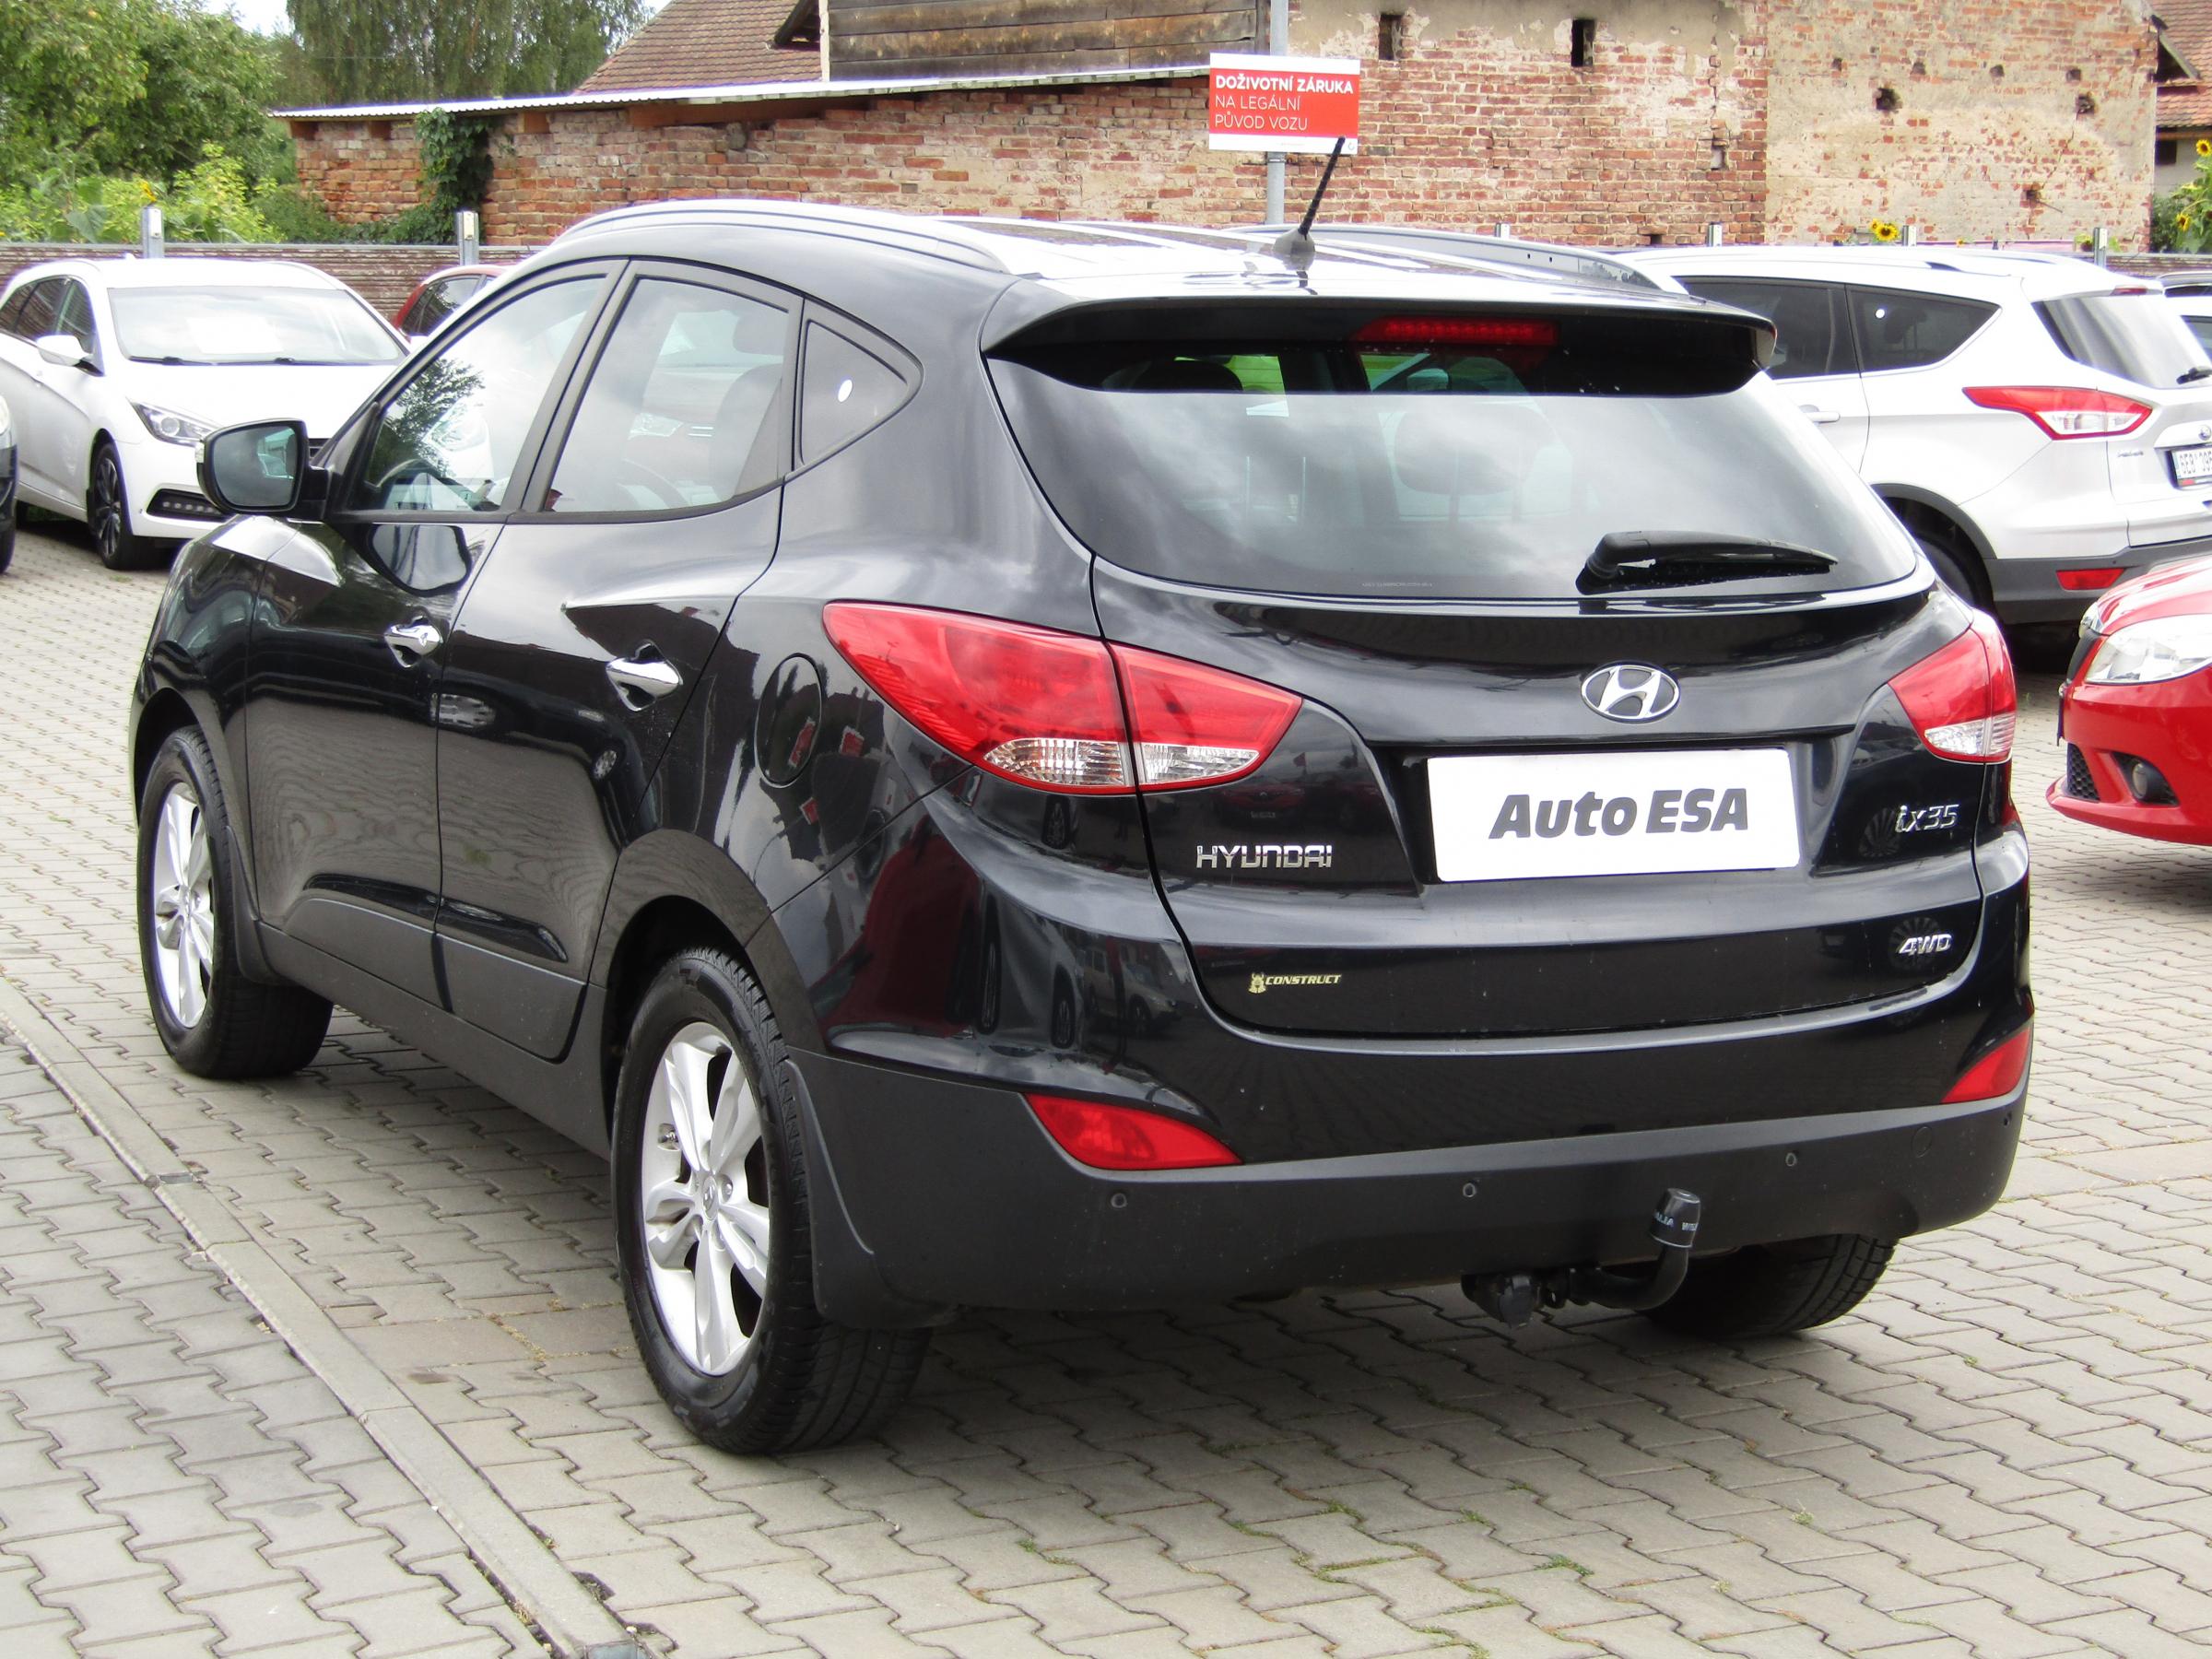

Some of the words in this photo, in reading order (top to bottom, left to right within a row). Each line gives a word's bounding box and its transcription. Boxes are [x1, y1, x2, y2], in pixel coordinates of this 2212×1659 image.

[1216, 73, 1294, 92] DOŽIVOTNÍ
[1297, 76, 1354, 94] ZÁRUKA
[1215, 95, 1236, 109] NA
[1241, 94, 1301, 112] LEGÁLNÍ
[1215, 112, 1265, 130] PŮVOD
[1269, 116, 1308, 131] VOZU
[1488, 791, 1638, 840] Auto
[1645, 787, 1748, 834] ESA
[1895, 804, 1959, 833] ix35
[1195, 844, 1333, 868] HYUNDAI
[1898, 934, 1953, 957] 4WD
[1265, 973, 1342, 986] CONSTRUCT
